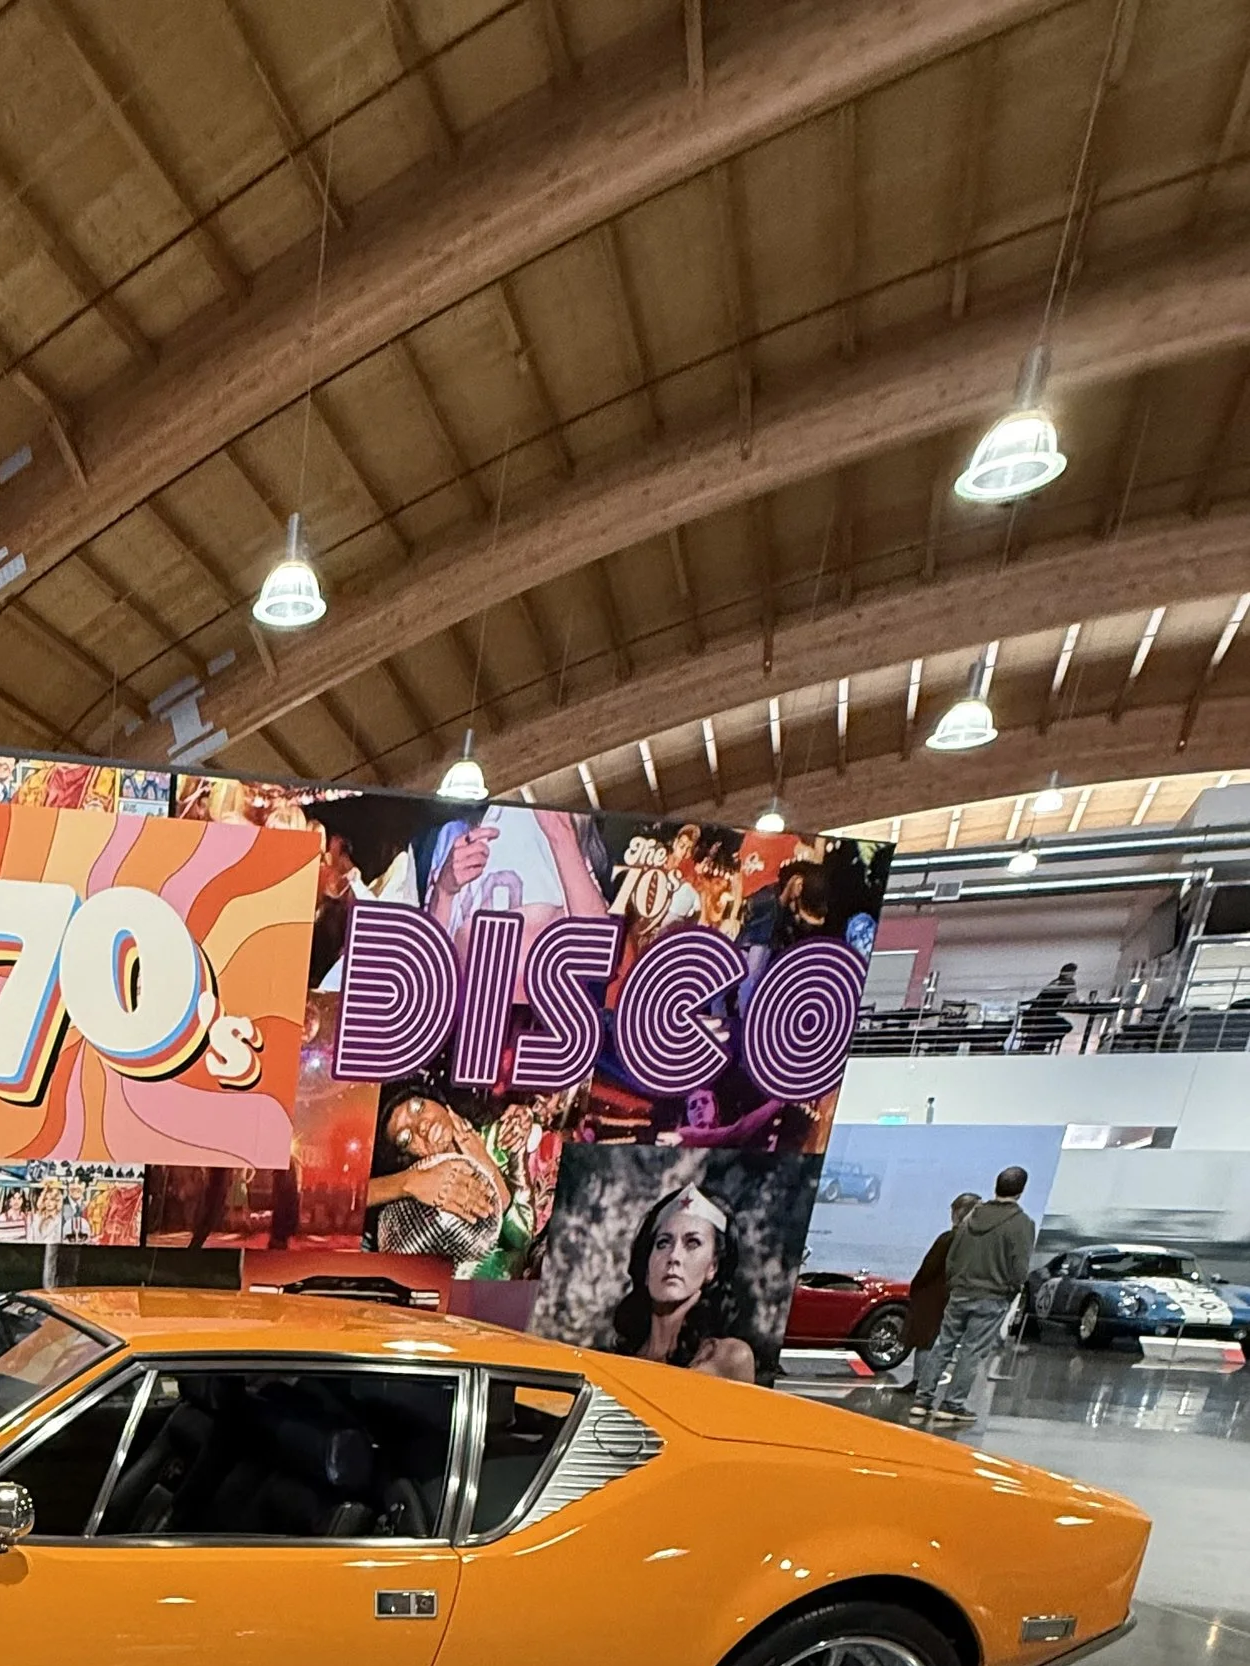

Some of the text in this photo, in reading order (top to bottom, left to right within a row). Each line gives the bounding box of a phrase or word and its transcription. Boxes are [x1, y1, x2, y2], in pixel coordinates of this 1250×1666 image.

[623, 836, 668, 867] The
[607, 865, 682, 930] 70s
[333, 902, 867, 1100] DISCO
